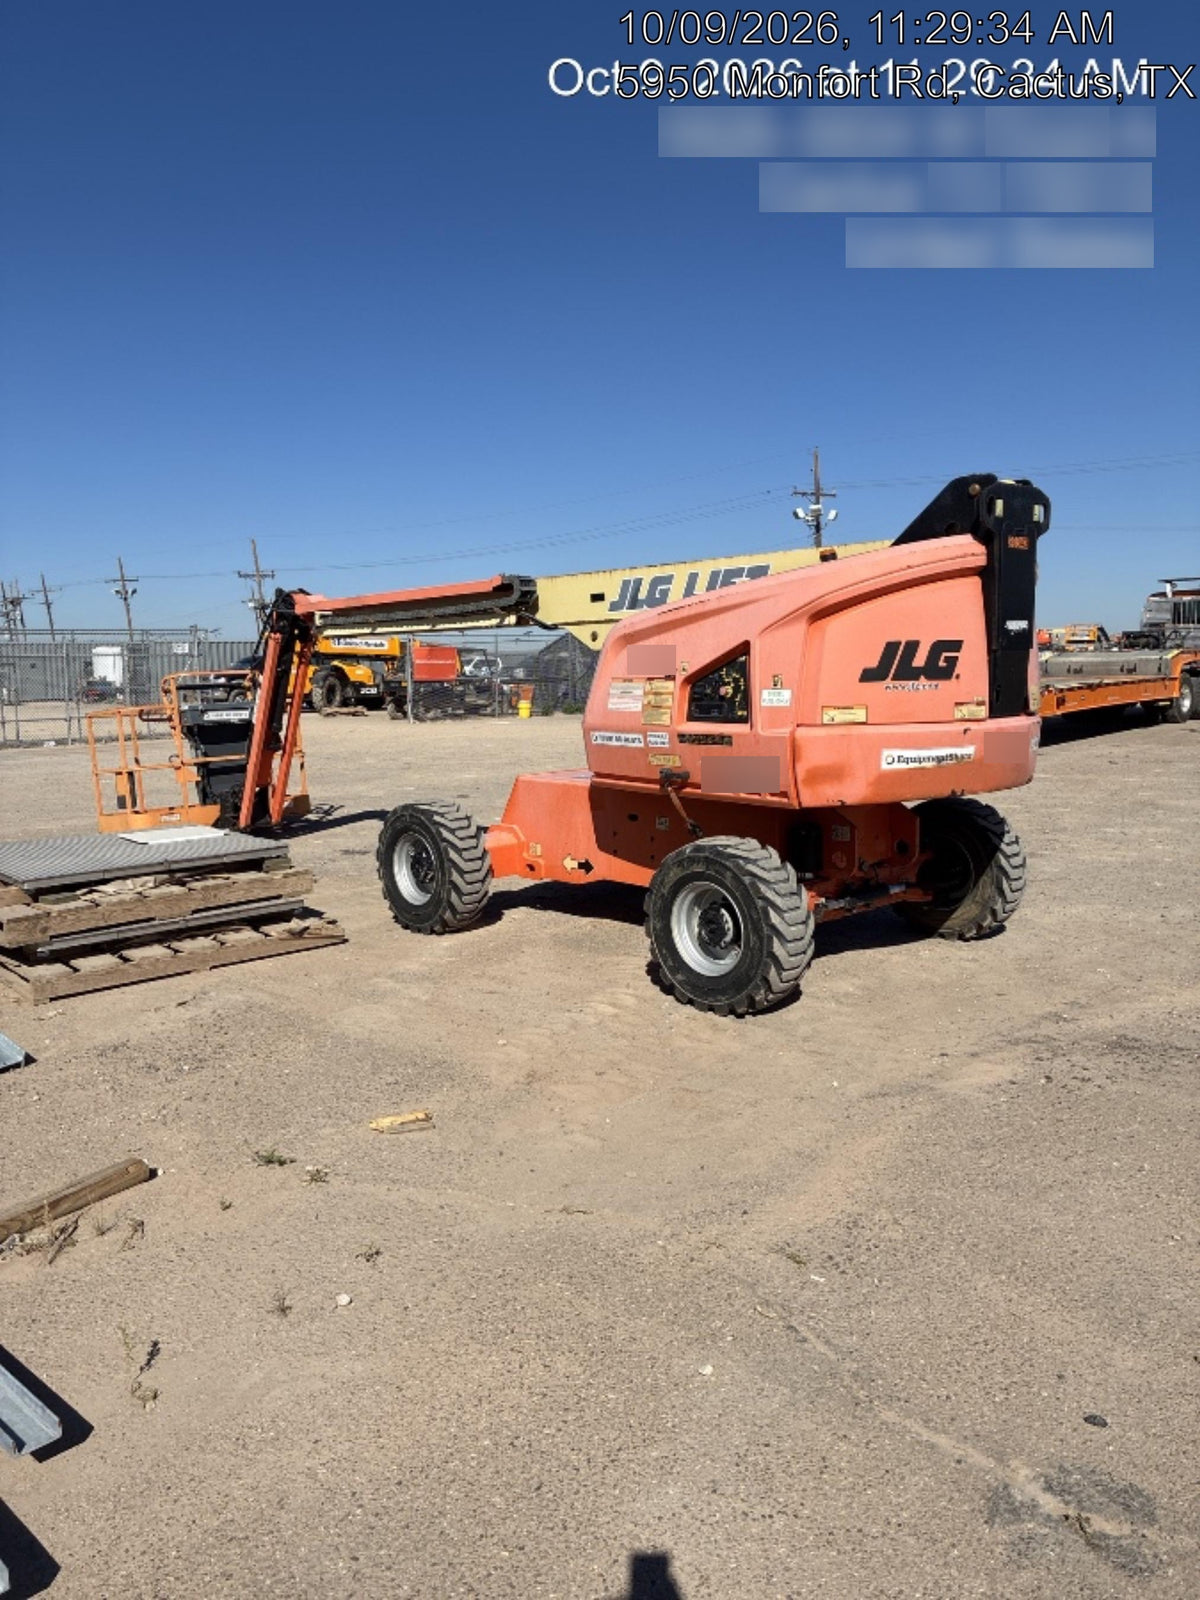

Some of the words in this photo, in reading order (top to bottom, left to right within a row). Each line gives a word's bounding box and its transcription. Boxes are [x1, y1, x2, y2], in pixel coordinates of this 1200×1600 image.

[608, 573, 675, 612] JLG
[682, 563, 772, 600] LIFT
[858, 639, 964, 683] JLG
